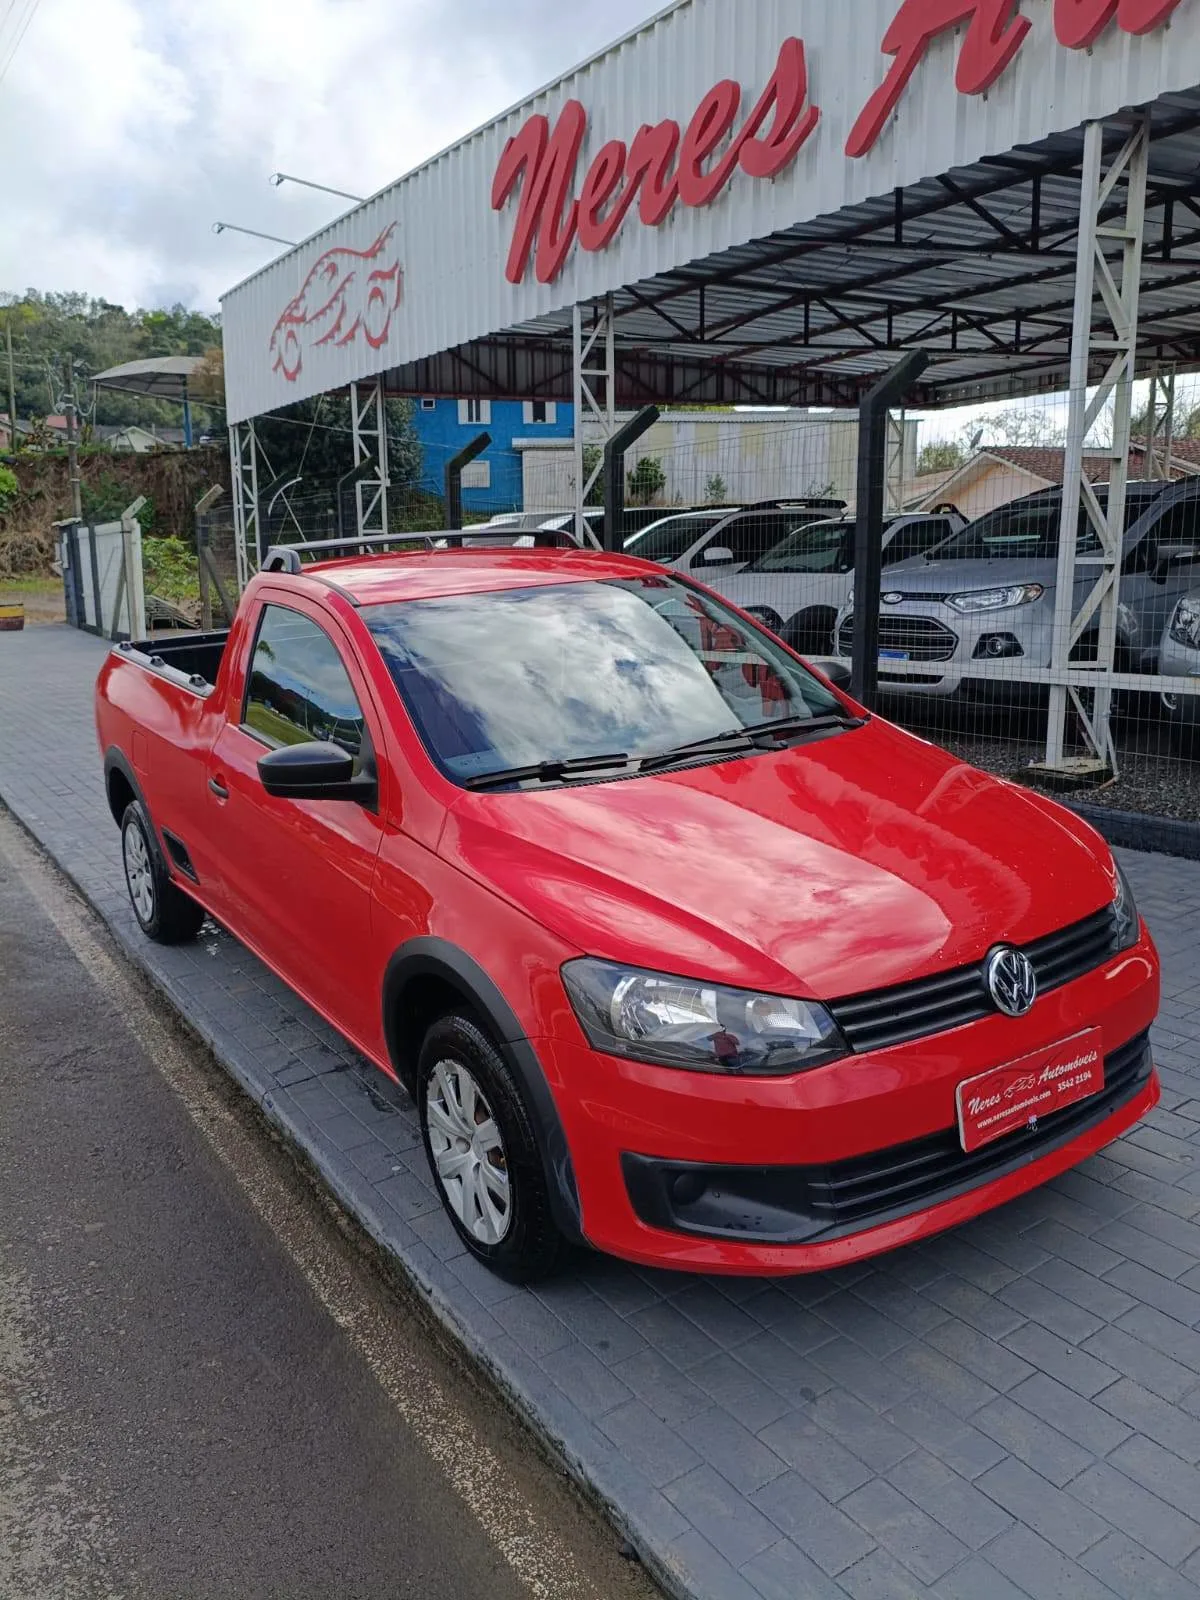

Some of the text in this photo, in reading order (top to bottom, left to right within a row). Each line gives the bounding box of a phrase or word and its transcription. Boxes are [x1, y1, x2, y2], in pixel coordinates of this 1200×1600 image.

[491, 37, 820, 284] Neres
[988, 948, 1036, 1017] VW
[968, 1093, 1001, 1115] Neres
